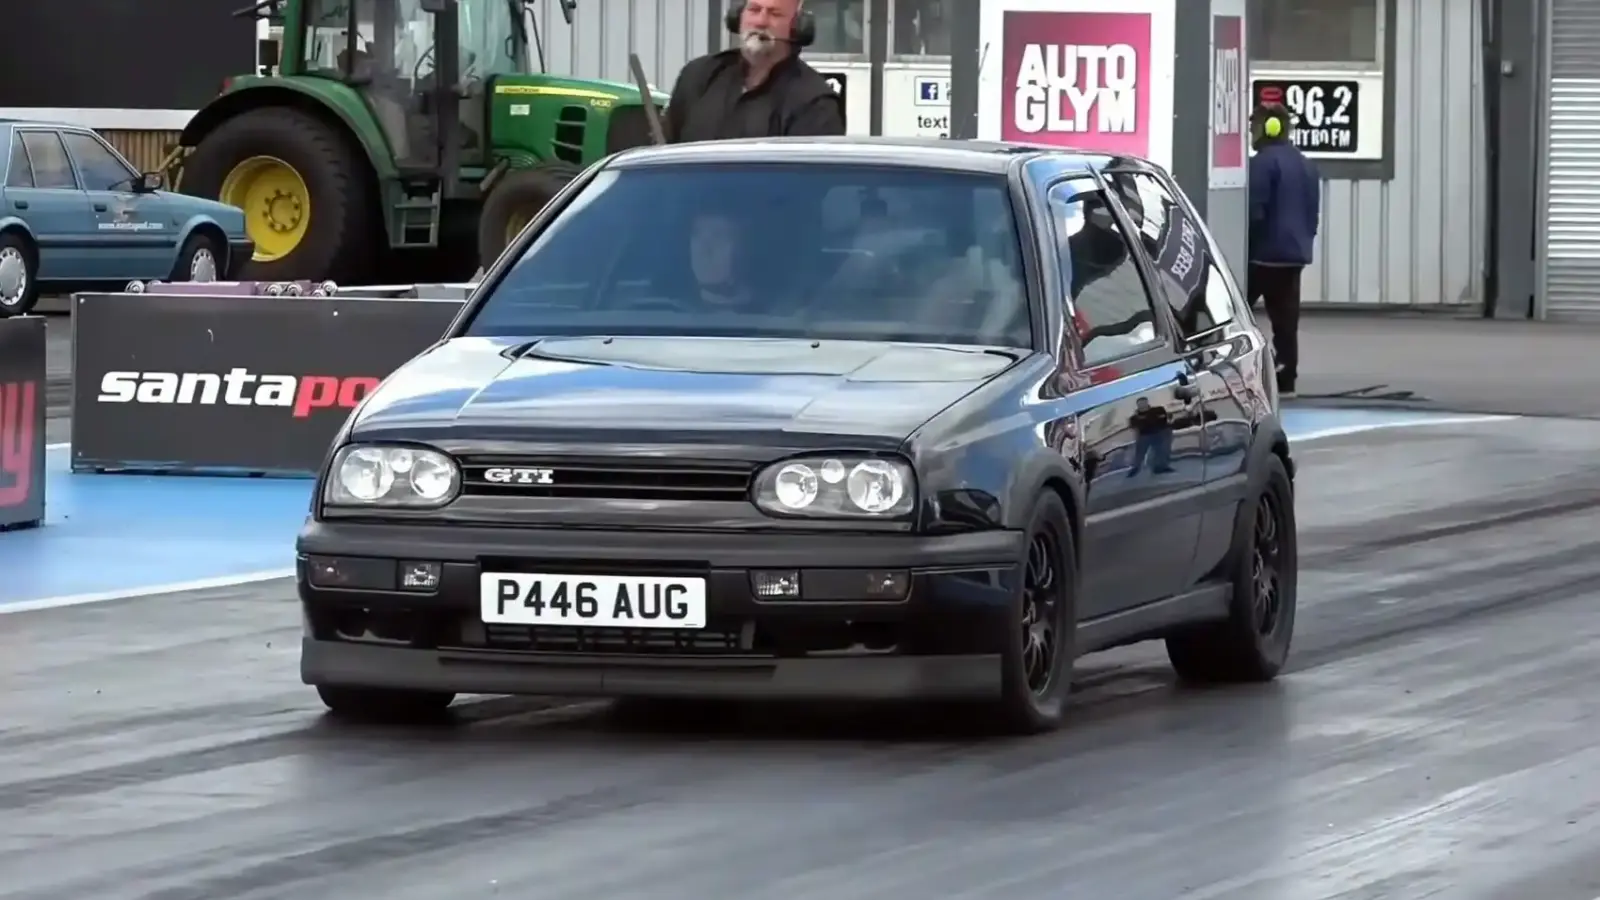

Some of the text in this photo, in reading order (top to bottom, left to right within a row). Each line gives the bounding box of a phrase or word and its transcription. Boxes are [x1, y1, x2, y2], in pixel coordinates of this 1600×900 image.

[1015, 43, 1136, 89] AUTO
[917, 114, 948, 129] text
[1015, 86, 1136, 133] GLYM
[1286, 85, 1352, 126] 96.2
[1331, 127, 1351, 147] FM
[484, 468, 554, 484] GTI
[497, 579, 688, 620] P446 AUG
